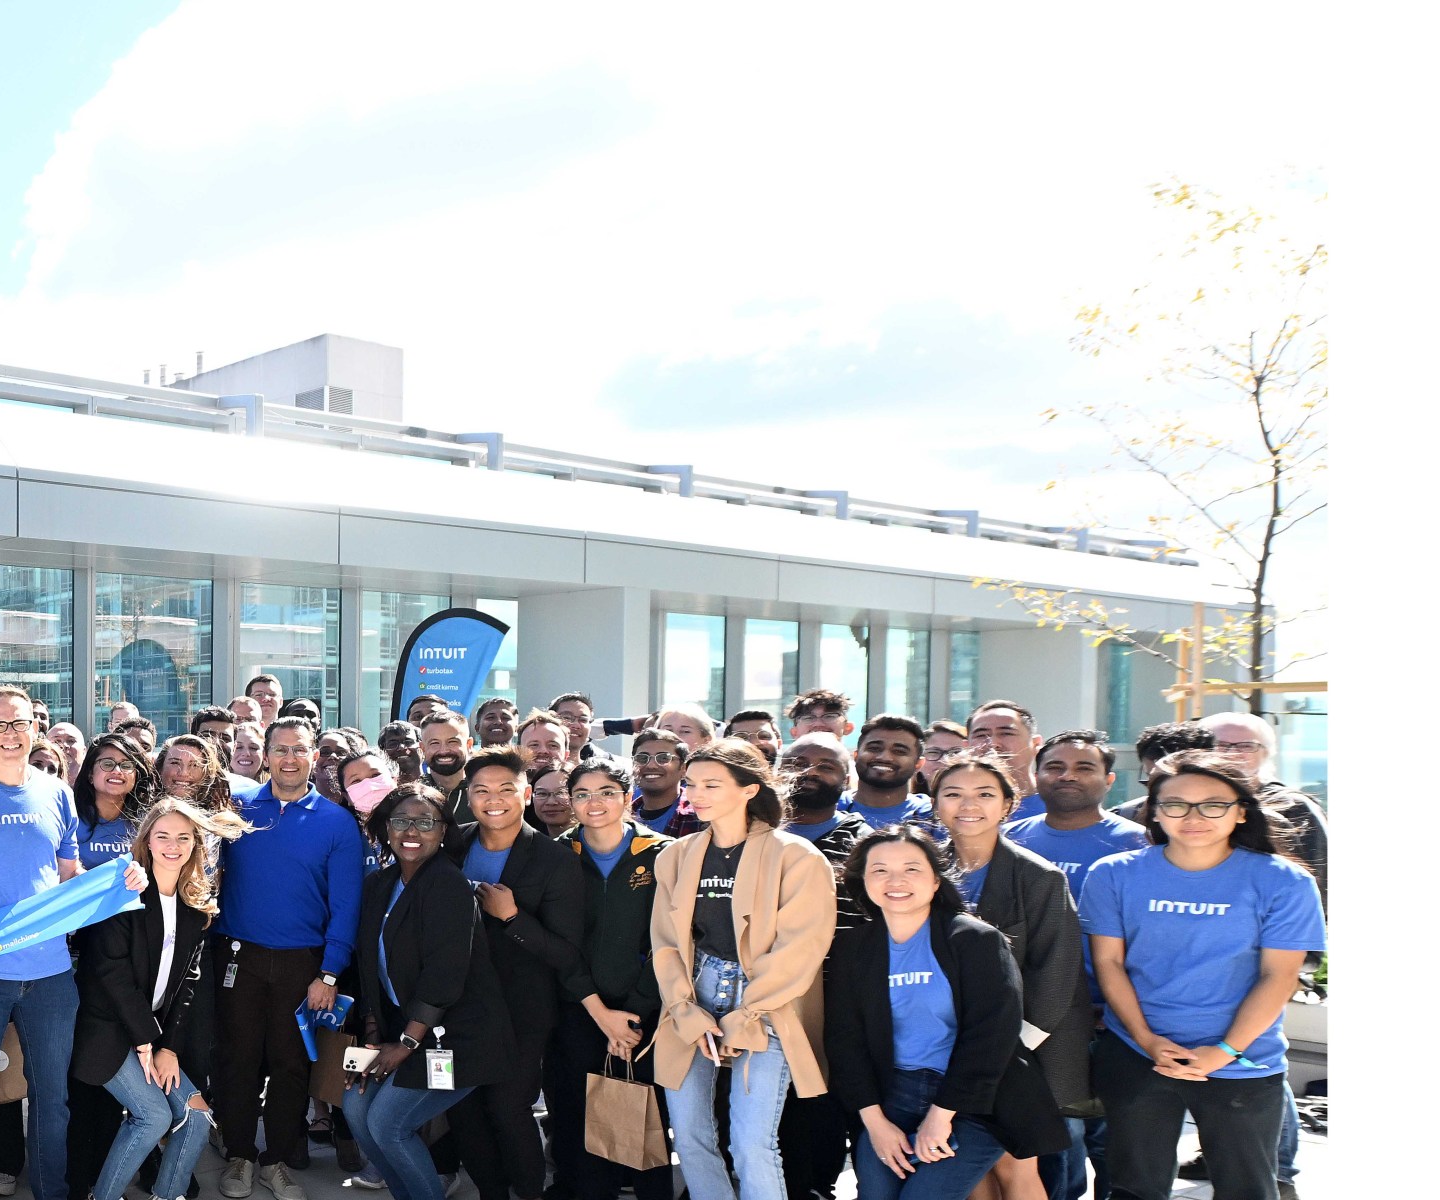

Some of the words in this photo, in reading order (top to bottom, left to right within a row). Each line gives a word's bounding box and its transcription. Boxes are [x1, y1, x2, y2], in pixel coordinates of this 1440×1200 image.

[419, 647, 467, 659] INTUIT
[90, 842, 132, 852] INTUIT
[1148, 899, 1231, 916] INTUIT
